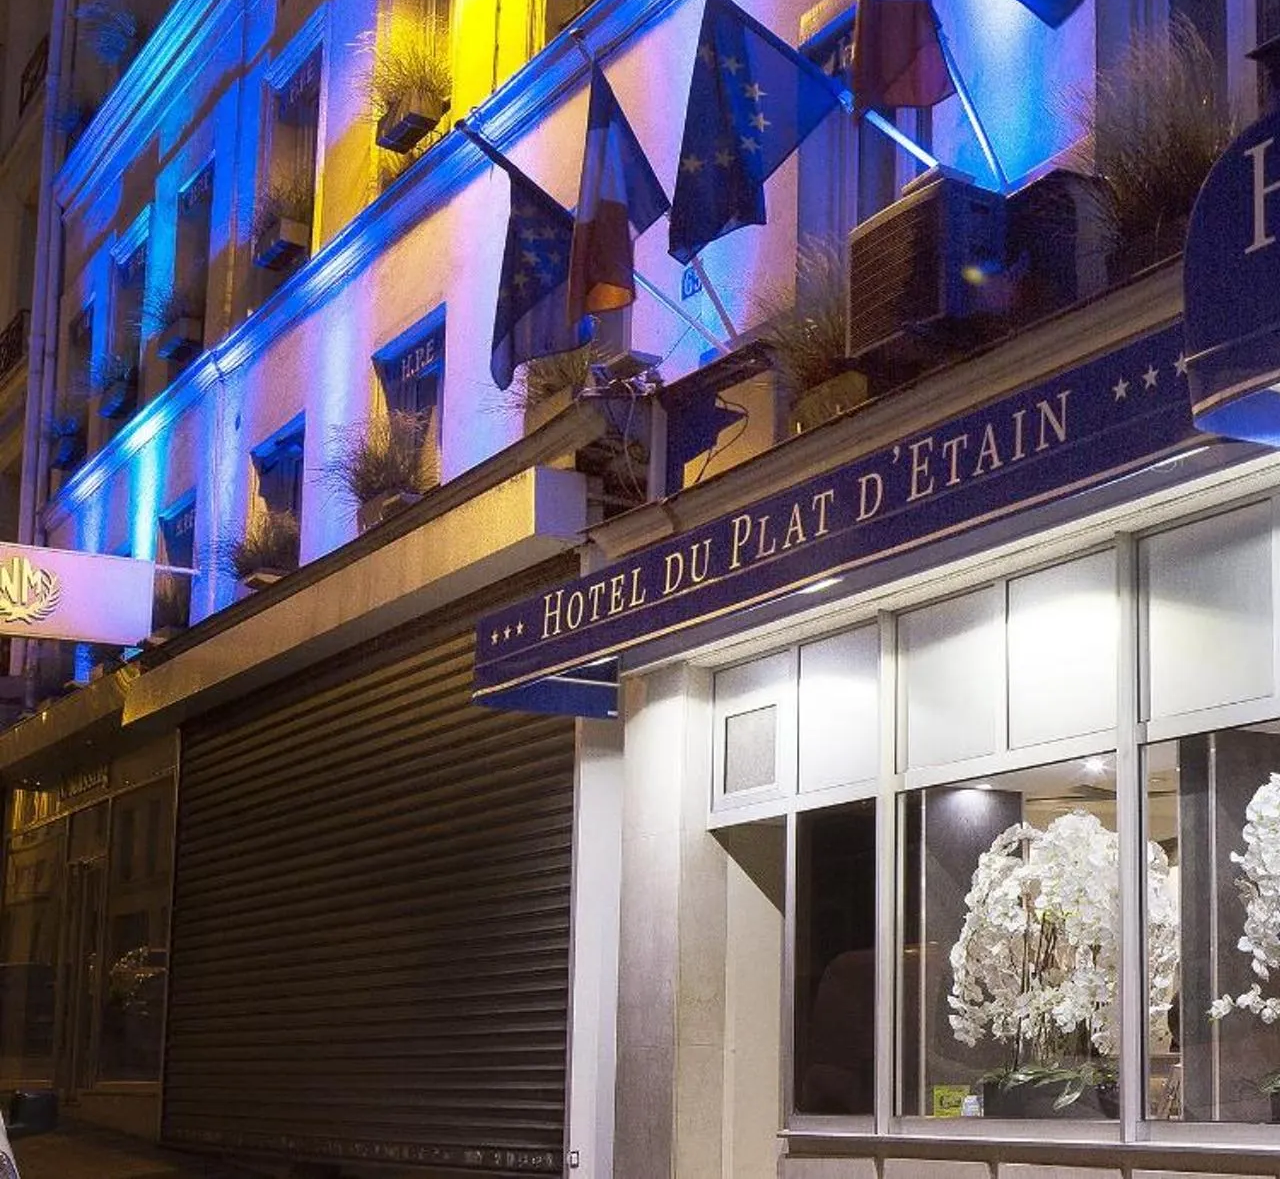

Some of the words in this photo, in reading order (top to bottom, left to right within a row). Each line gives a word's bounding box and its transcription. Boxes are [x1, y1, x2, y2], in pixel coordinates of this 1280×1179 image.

[541, 567, 646, 638] HOTEL
[662, 538, 711, 595] DU
[729, 488, 835, 569] PLAT
[856, 391, 1070, 521] D'ETAIN
